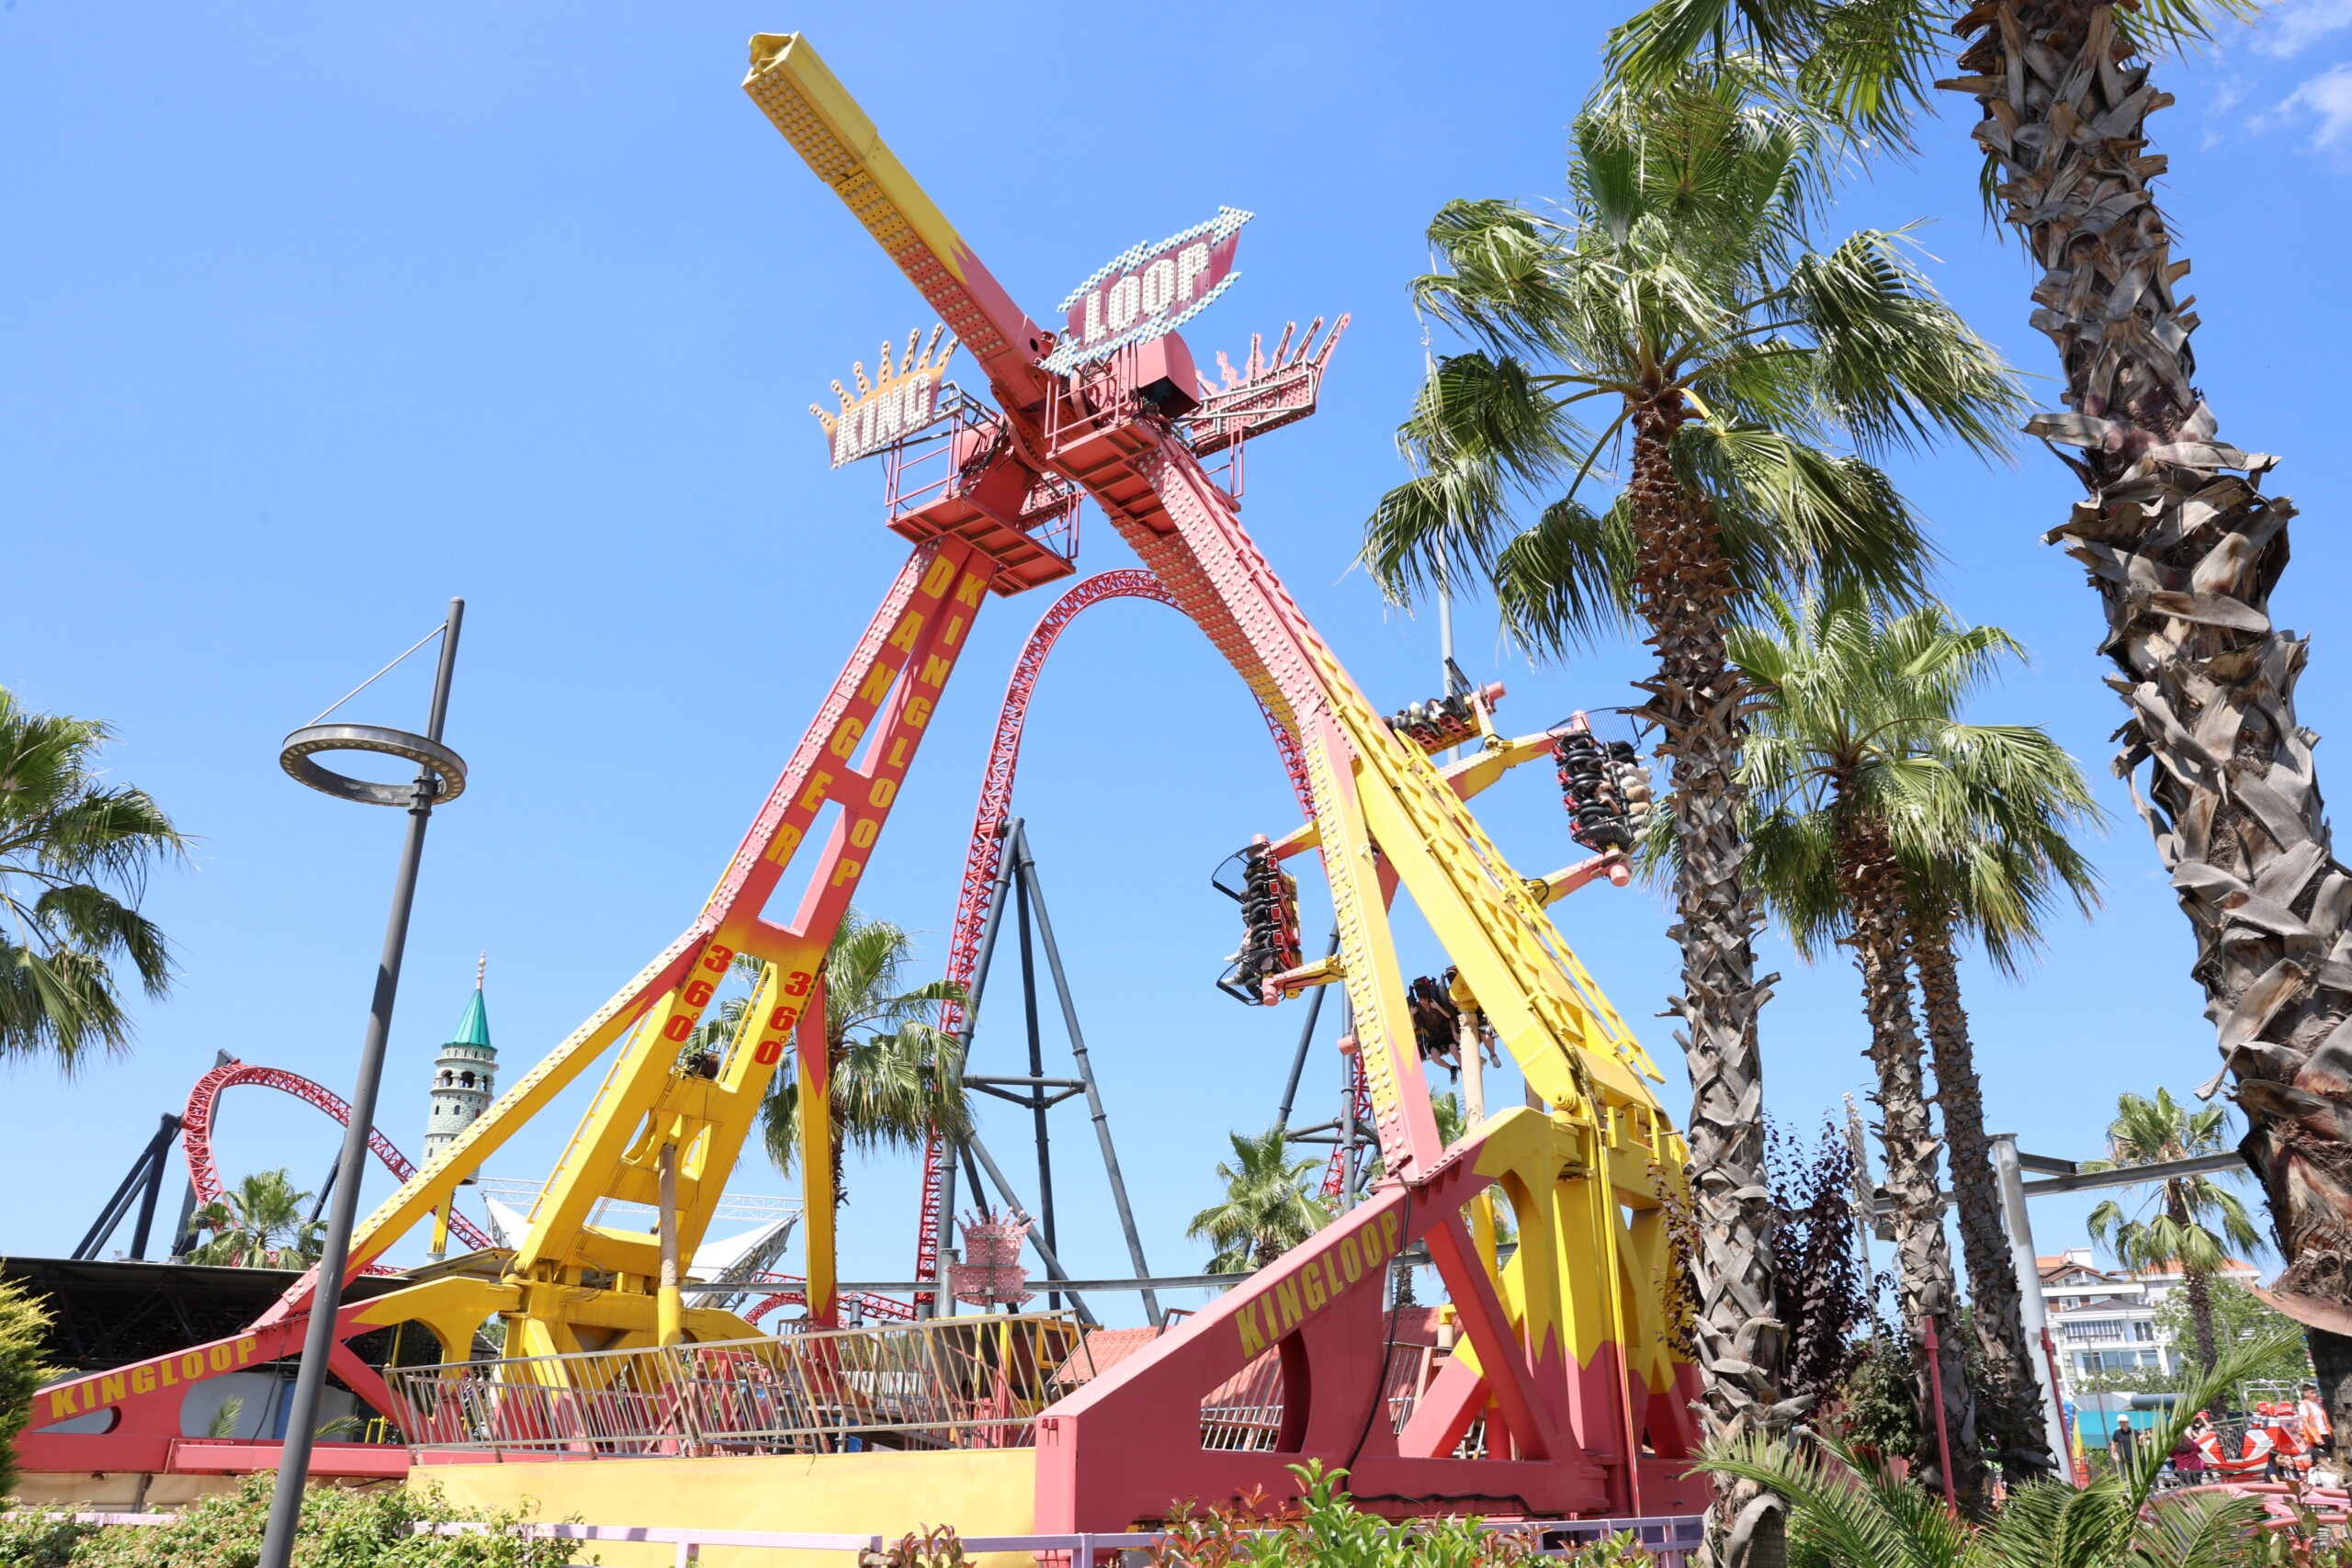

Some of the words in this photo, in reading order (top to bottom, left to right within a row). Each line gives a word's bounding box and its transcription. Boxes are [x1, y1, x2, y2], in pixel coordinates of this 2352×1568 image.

[1084, 243, 1208, 344] LOOP
[834, 372, 931, 464] KING
[764, 554, 956, 867] DANGER
[831, 572, 987, 886] KINGLOOP
[1235, 1210, 1397, 1359] KINGLOOP
[50, 1337, 257, 1418] KINGLOOP
